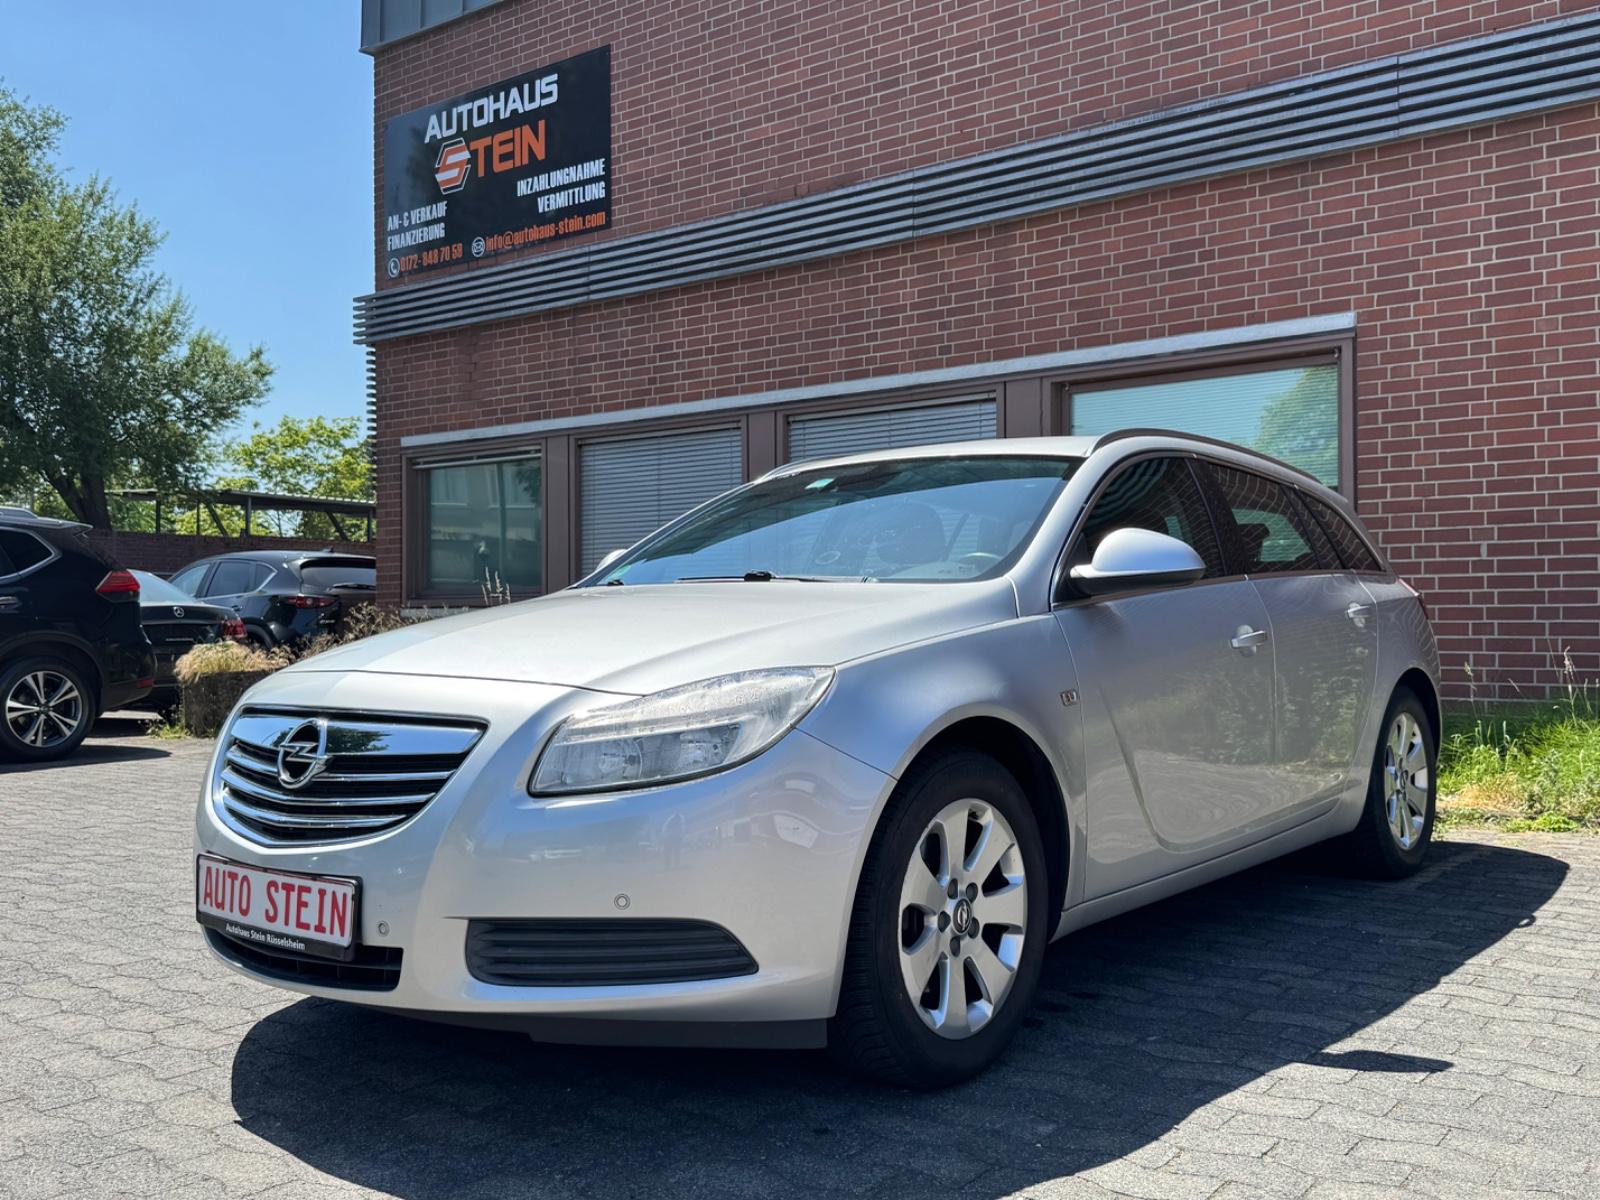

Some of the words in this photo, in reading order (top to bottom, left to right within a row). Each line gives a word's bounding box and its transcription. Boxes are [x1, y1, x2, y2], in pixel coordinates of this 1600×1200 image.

[424, 73, 558, 143] AUTOHAUS
[435, 119, 547, 190] STEIN
[517, 158, 605, 197] INZAHLUNGNAHME
[410, 201, 448, 225] VERKAUF
[537, 181, 605, 213] VERMITTLUNG
[387, 222, 446, 252] FINANZIERUNG
[486, 211, 606, 251] info@autohaus-stein.com
[440, 246, 450, 262] 70
[203, 866, 252, 917] AUTO
[265, 880, 347, 938] STEIN
[225, 923, 250, 939] Autohaus
[250, 929, 266, 942] Stein
[266, 933, 306, 950] Rüsselsheim
